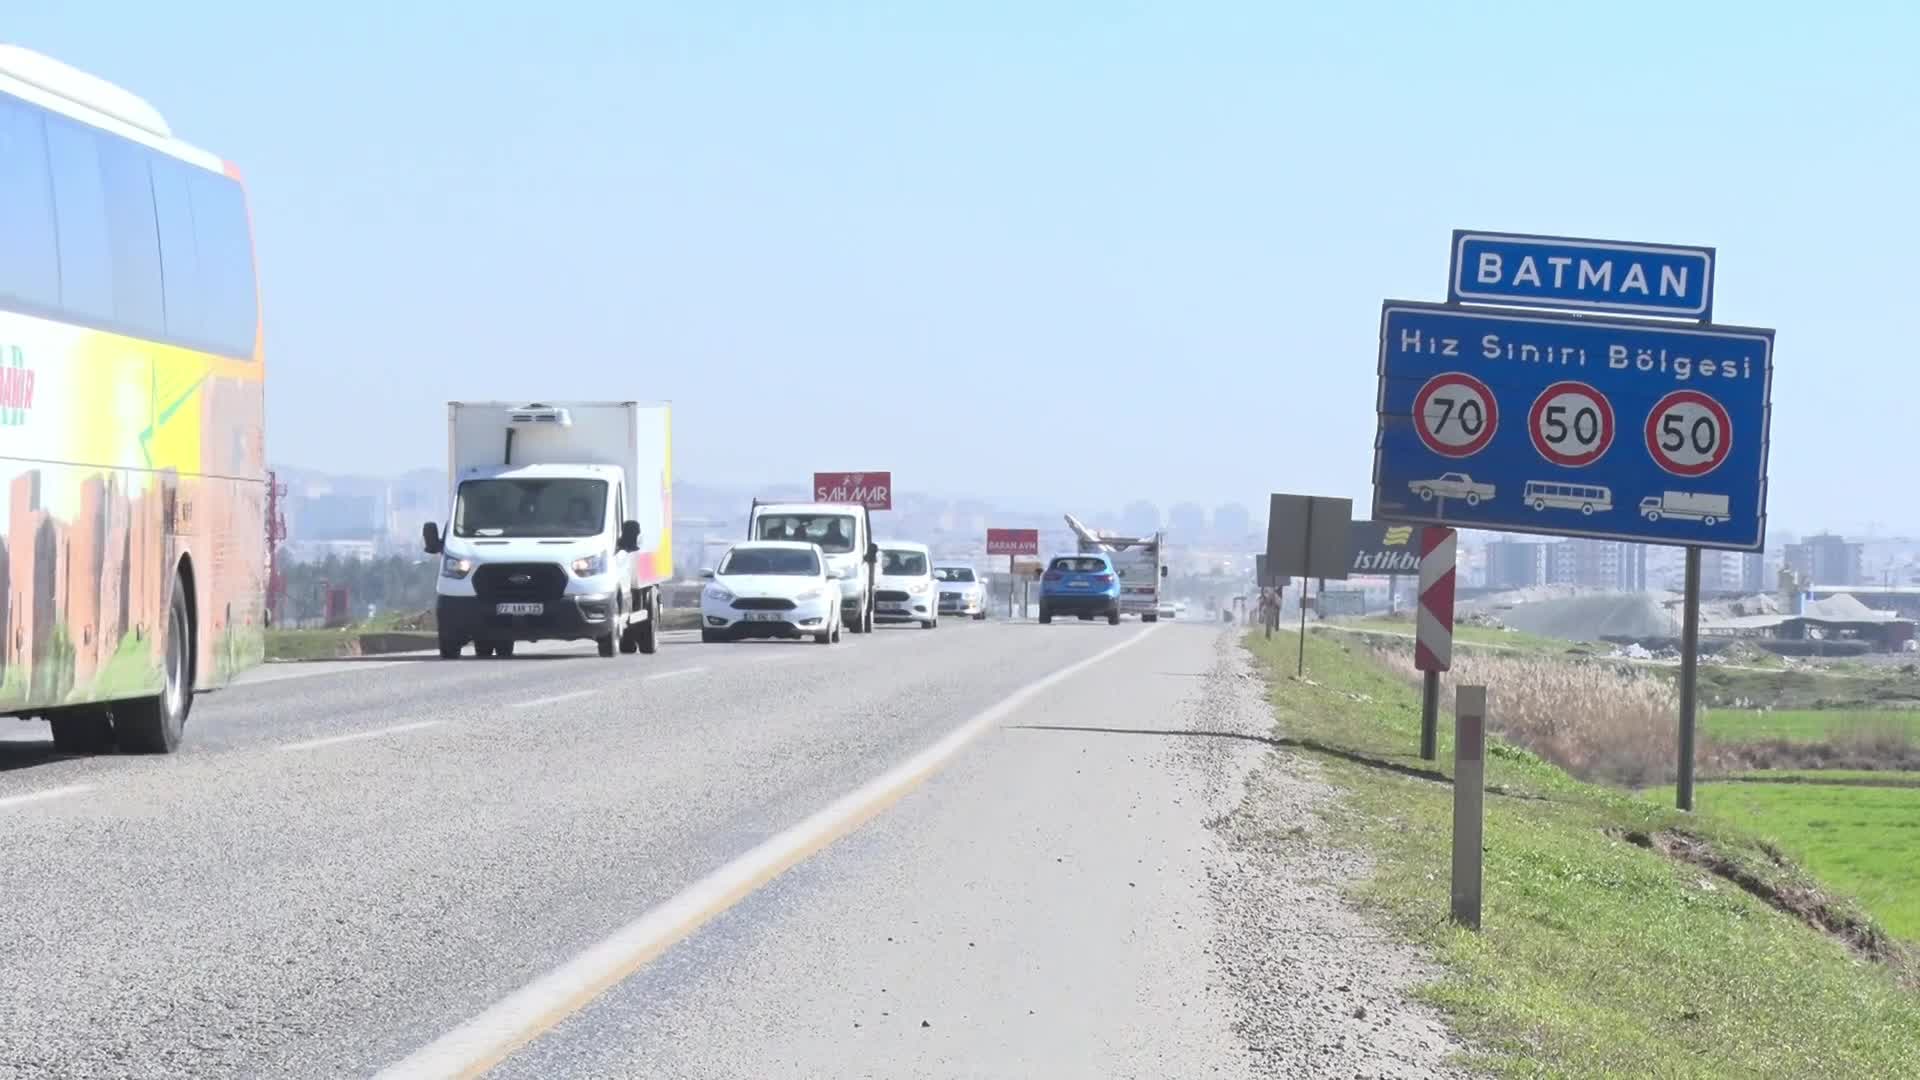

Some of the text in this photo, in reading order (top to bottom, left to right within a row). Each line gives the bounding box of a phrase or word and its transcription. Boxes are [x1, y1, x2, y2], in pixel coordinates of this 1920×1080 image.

[1477, 251, 1689, 298] BATMAN
[1401, 328, 1460, 356] Hız
[1608, 344, 1751, 380] Bölgesi
[1432, 397, 1484, 436] 70
[1544, 405, 1599, 446] 50
[1661, 413, 1716, 455] 50
